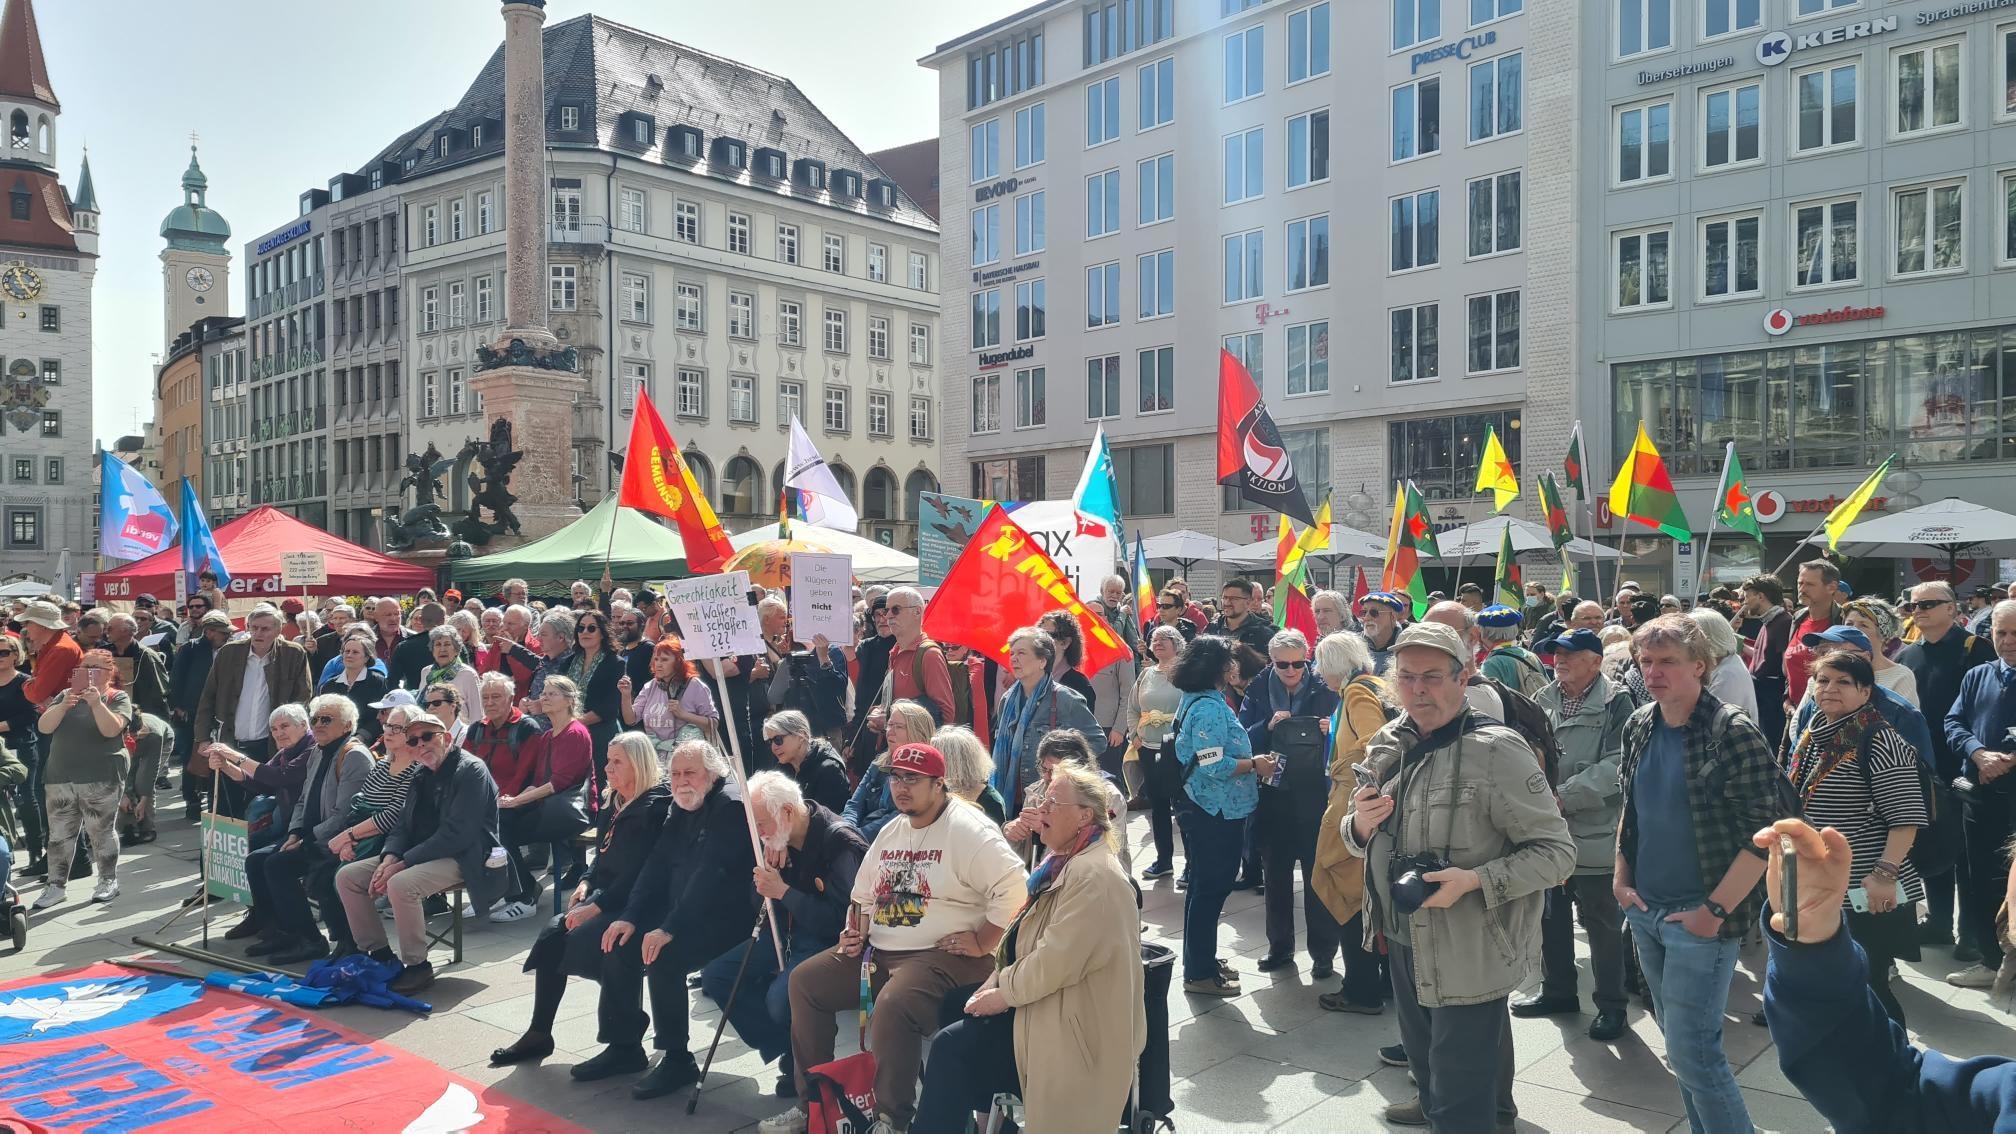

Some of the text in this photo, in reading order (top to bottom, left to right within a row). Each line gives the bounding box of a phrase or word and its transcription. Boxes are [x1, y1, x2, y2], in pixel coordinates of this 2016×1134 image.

[1797, 15, 1898, 50] KERN
[1637, 56, 1733, 85] Übersetzungen
[1798, 306, 1885, 326] vodafone
[979, 344, 1034, 365] Hugendubel
[1028, 530, 1073, 557] ax
[814, 564, 828, 572] Die
[668, 577, 739, 604] Gerechtigkeit
[804, 575, 837, 586] Klügeren
[809, 589, 833, 598] geben
[687, 604, 736, 620] mit Waffen
[811, 602, 832, 611] nicht
[693, 616, 748, 636] zu schaffen
[710, 631, 731, 652] ???
[203, 827, 249, 858] KRIEG
[223, 854, 246, 872] GRÖSST
[880, 849, 943, 864] IRON MAIDEN
[206, 863, 251, 892] LIMAKILLER
